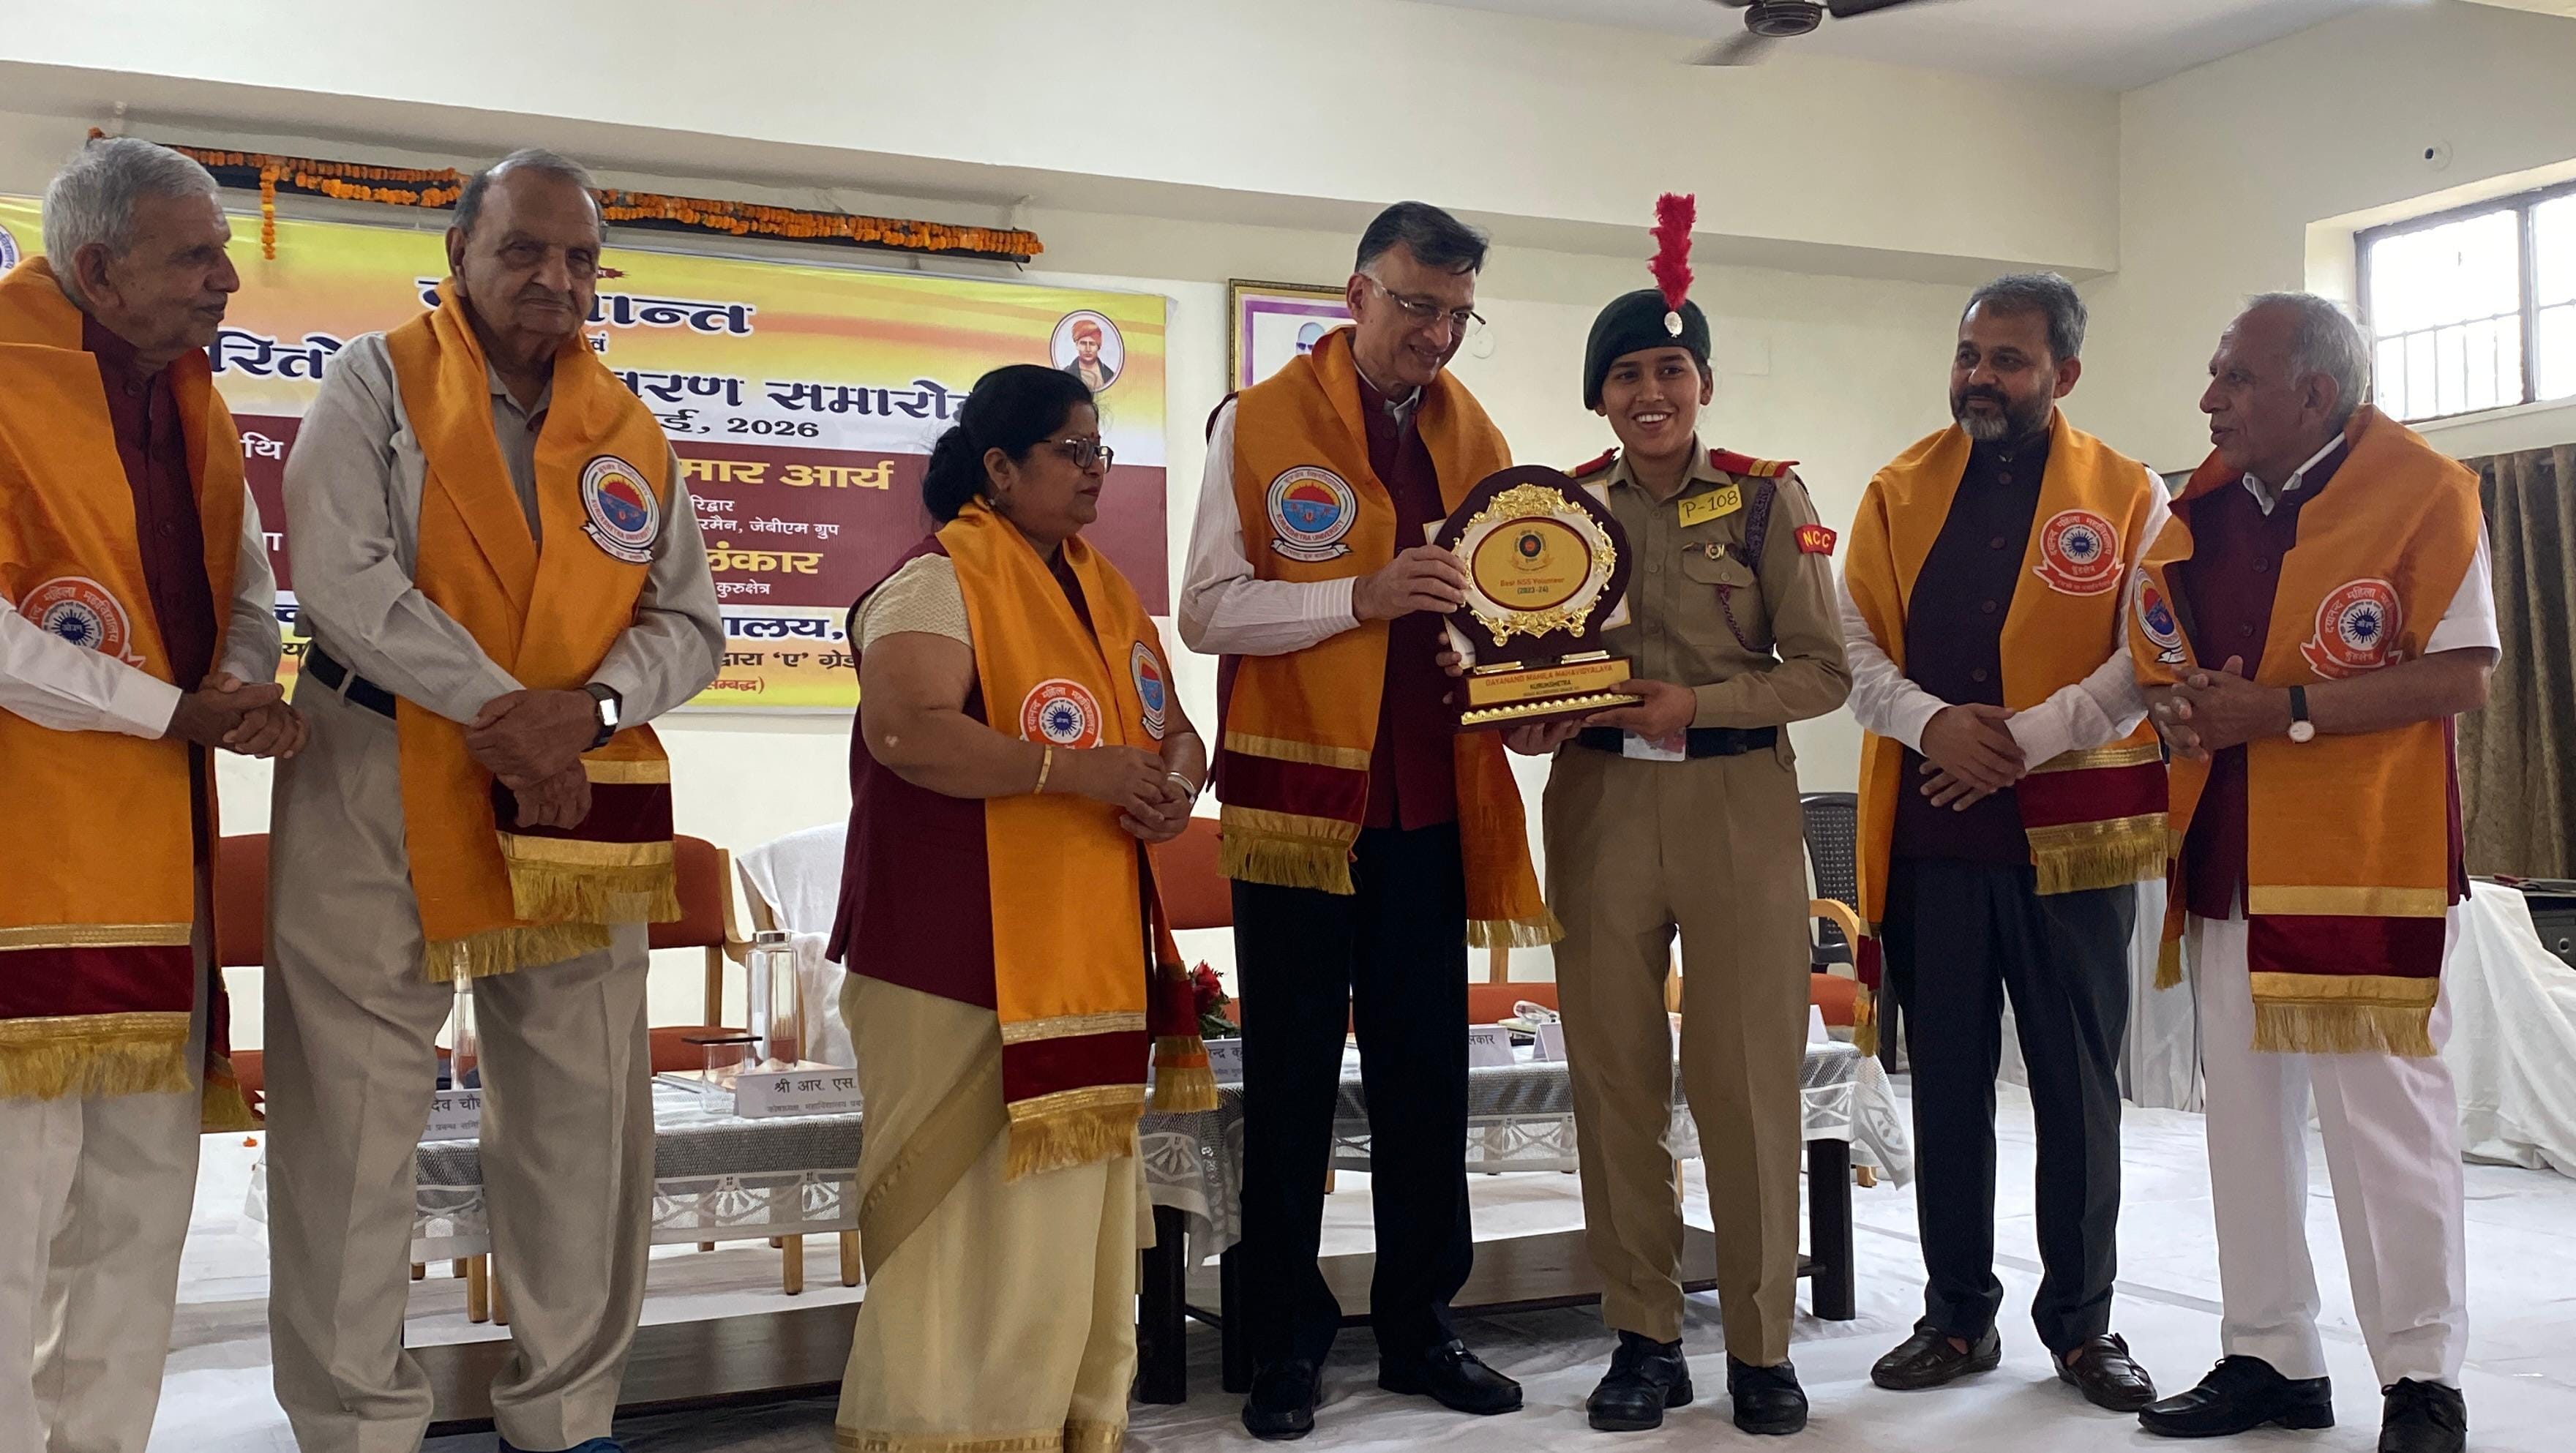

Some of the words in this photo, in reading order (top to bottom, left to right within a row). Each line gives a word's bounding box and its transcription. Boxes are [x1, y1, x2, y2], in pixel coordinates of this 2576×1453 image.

[765, 380, 967, 420] समारो
[654, 410, 710, 434] ई,
[727, 417, 820, 438] 2026
[678, 458, 771, 484] मार
[779, 460, 895, 490] आर्य
[689, 495, 735, 512] रिद्वार
[1682, 490, 1739, 519] P-108
[697, 515, 744, 534] रमैन,
[749, 517, 809, 535] जेबीएम
[814, 523, 840, 540] ग्रुप
[1802, 531, 1831, 549] NCC
[705, 540, 824, 574] लंकार
[716, 579, 771, 598] कुरुक्षेत्र
[722, 617, 844, 640] ालय,
[1486, 676, 1525, 686] DAYANAND
[1526, 670, 1553, 683] MAHILA
[1555, 664, 1613, 677] MAHAVIDYALAYA
[774, 1078, 790, 1093] श्री
